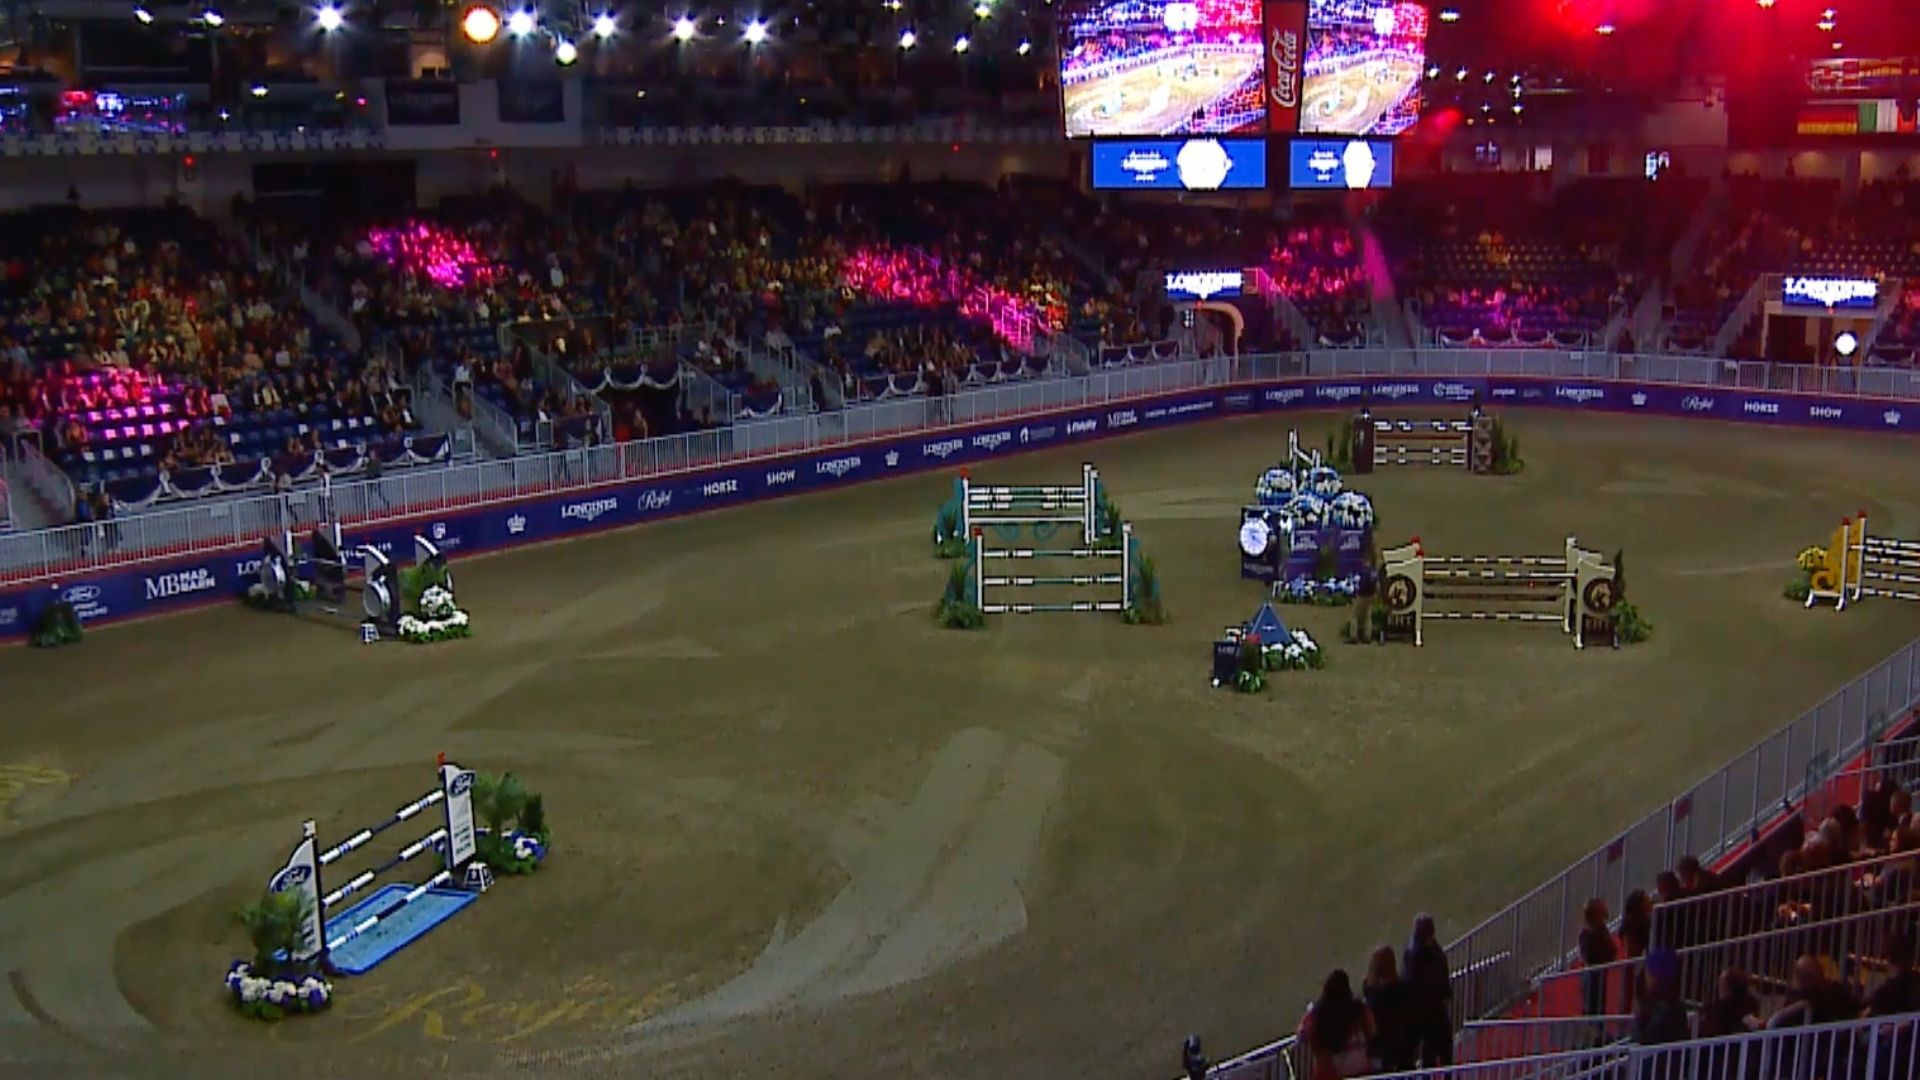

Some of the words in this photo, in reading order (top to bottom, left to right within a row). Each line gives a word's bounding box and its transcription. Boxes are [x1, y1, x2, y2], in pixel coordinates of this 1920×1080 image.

[1270, 27, 1297, 108] Coca-Cola
[1744, 400, 1779, 414] HORSE
[1809, 406, 1842, 419] SHOW
[703, 479, 738, 497] HORSE
[766, 469, 796, 487] SHOW
[561, 497, 618, 519] LONGINES
[180, 568, 209, 583] MAD
[180, 576, 217, 593] BARN
